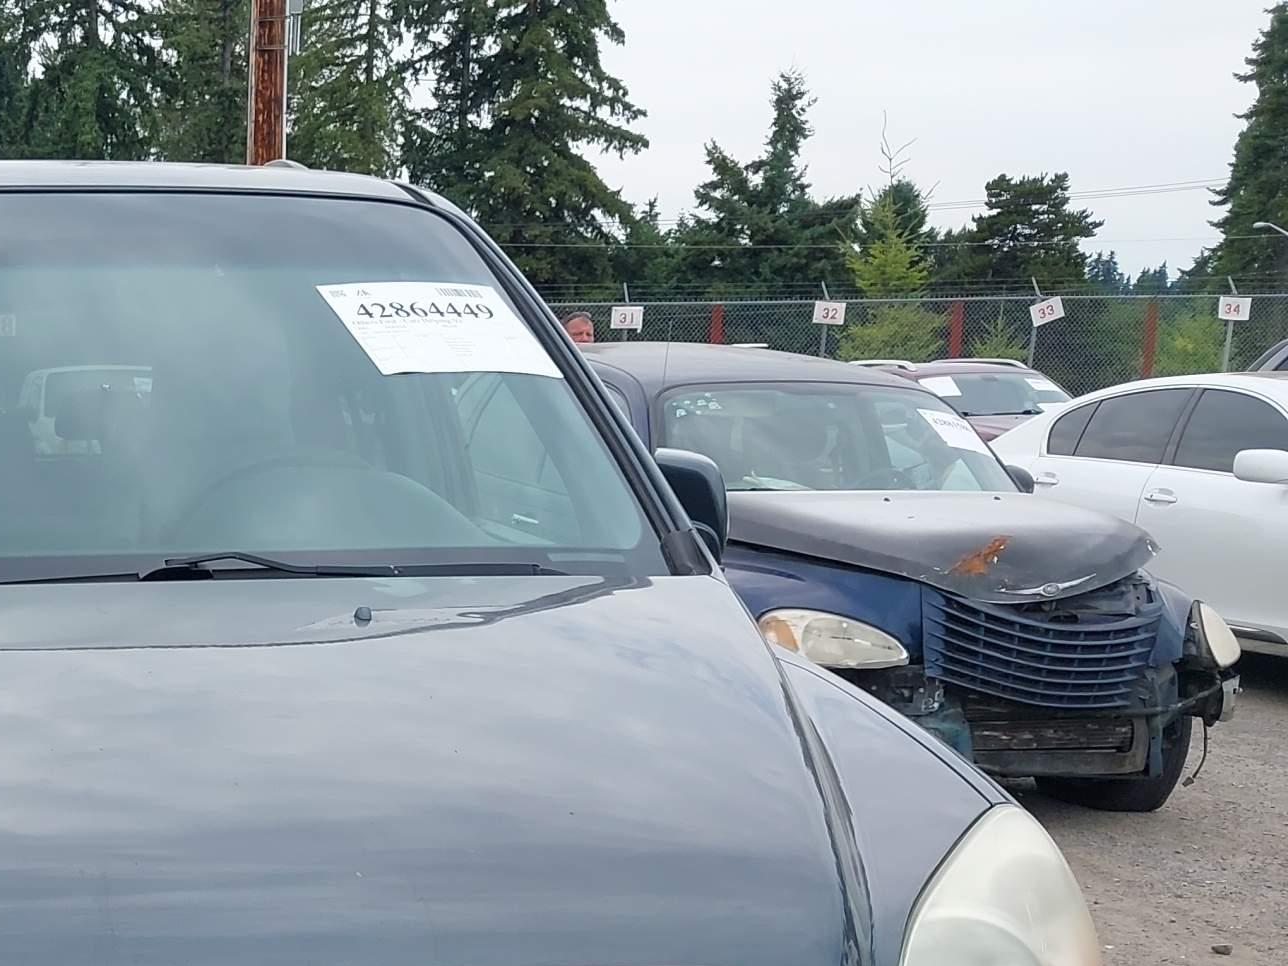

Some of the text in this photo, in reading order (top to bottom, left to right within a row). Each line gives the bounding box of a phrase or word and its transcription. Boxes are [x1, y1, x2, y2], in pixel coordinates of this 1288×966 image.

[357, 301, 494, 320] 42864449
[822, 307, 838, 320] 32
[1038, 304, 1055, 319] 33
[1224, 303, 1241, 315] 34
[619, 313, 634, 324] 31
